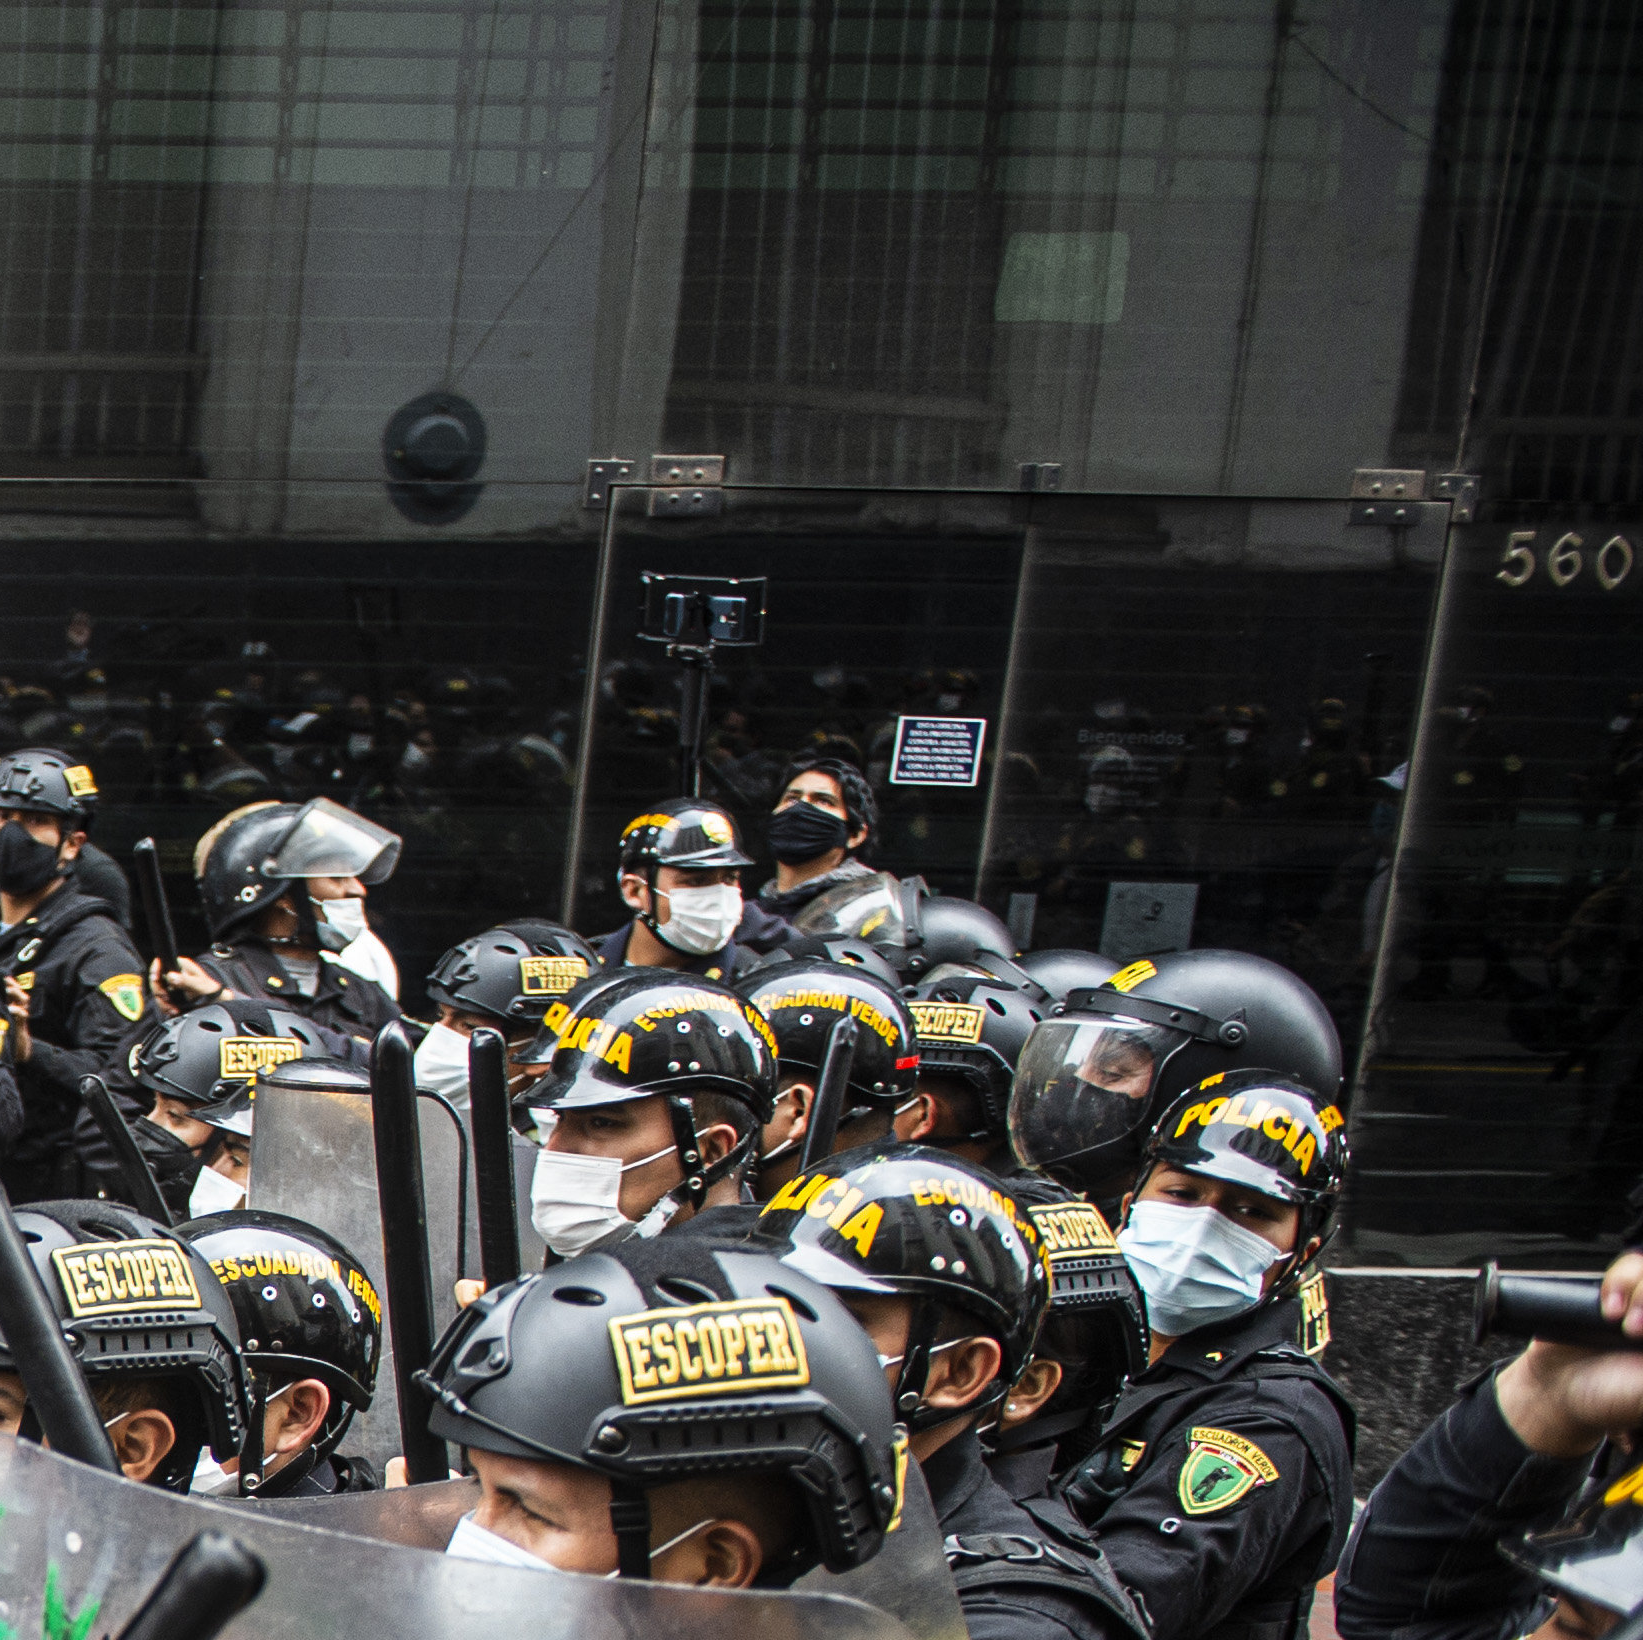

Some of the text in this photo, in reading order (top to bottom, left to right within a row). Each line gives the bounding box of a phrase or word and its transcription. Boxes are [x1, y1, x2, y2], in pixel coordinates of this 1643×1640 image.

[1496, 531, 1634, 590] 560
[1077, 728, 1187, 746] Bienvenidos
[633, 992, 744, 1033] ESCUADRON
[850, 998, 900, 1048] VERDE
[1174, 1097, 1317, 1178] POLICIA
[65, 1248, 192, 1306] ESCOPER
[623, 1310, 799, 1386] ESCOPER
[1193, 1430, 1251, 1455] ESCUADRON
[1251, 1452, 1275, 1478] VERDE
